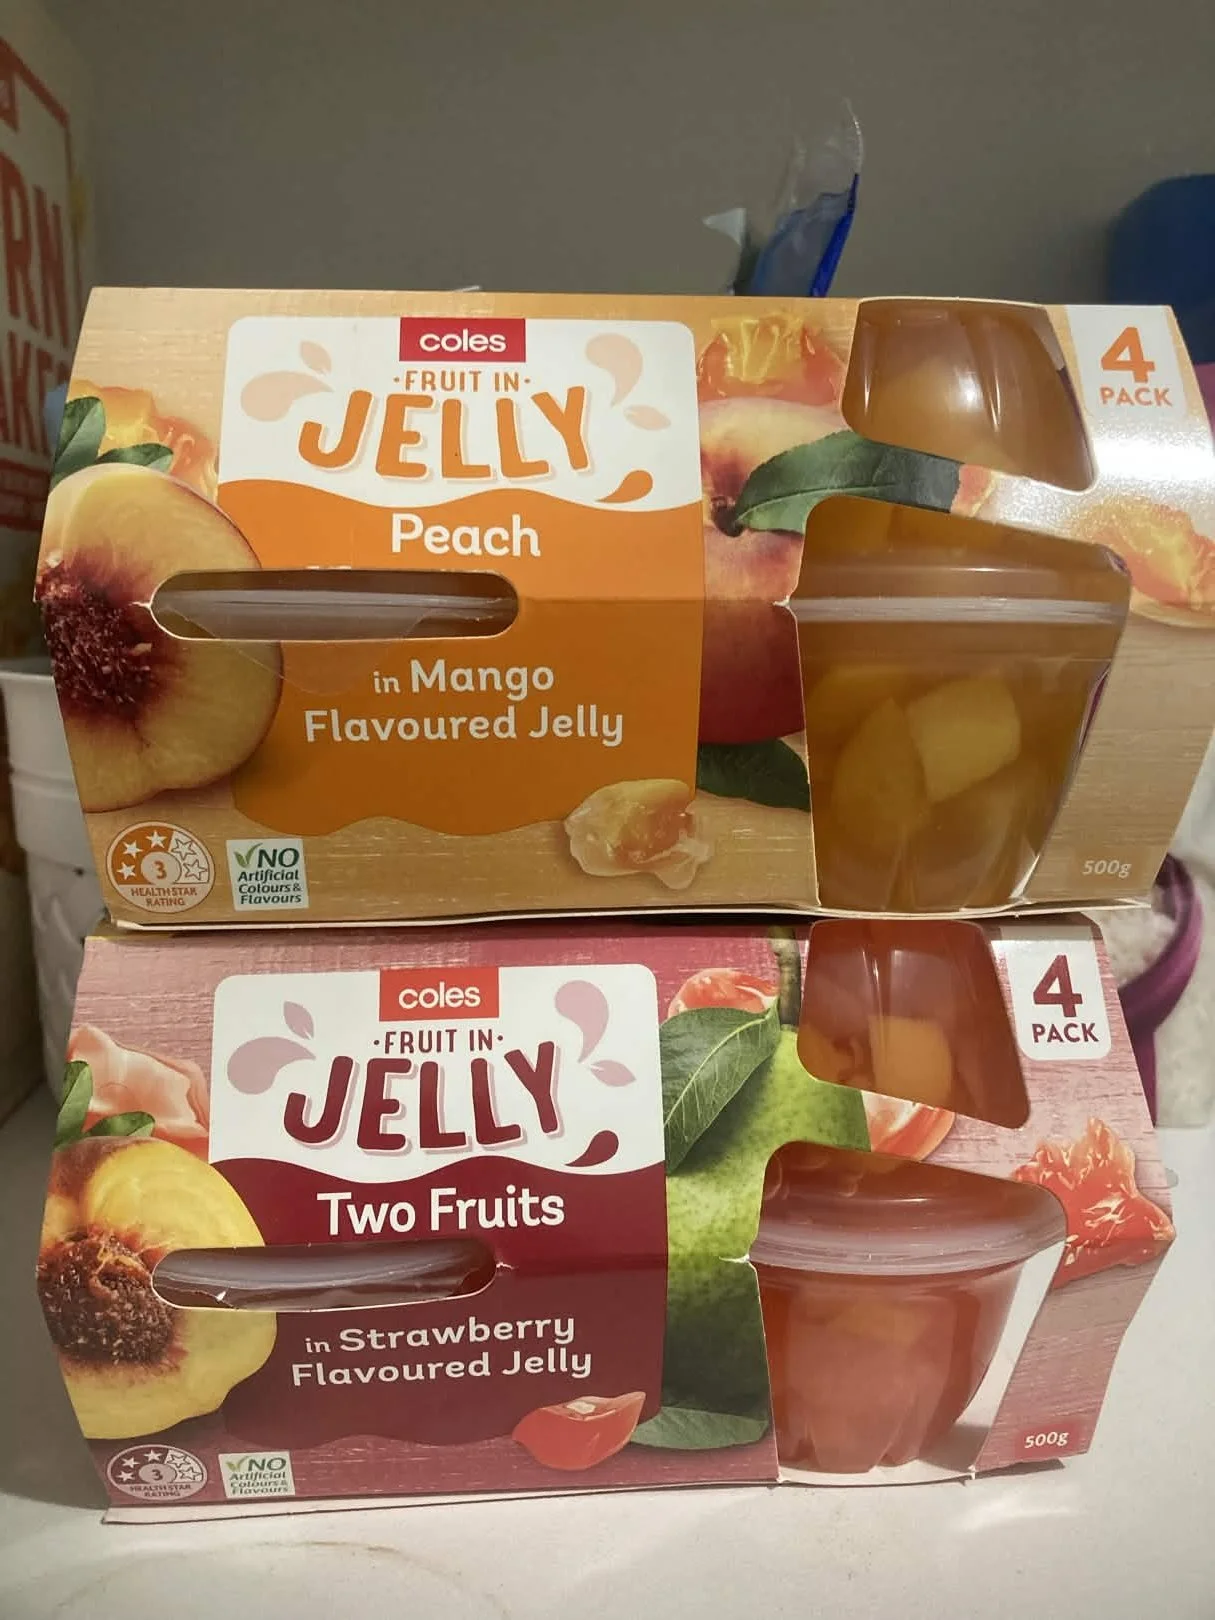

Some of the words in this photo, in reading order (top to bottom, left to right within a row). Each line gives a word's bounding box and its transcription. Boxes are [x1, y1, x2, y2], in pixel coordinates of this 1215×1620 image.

[419, 329, 506, 353] coles
[1101, 326, 1155, 383] 4
[405, 370, 482, 392] FRUIT
[494, 371, 520, 391] IN
[1100, 387, 1172, 407] PACK
[298, 385, 590, 480] JELLY
[391, 513, 541, 557] Peach
[373, 671, 401, 694] in
[410, 659, 555, 701] Mango
[304, 706, 517, 743] Flavoured
[528, 704, 624, 747] Jelly
[256, 848, 300, 868] NO
[152, 861, 167, 879] 3
[238, 869, 299, 883] Artificial
[1082, 860, 1132, 879] 500g
[131, 888, 171, 897] HEALTH
[172, 887, 198, 896] STAR
[238, 883, 291, 895] Colours
[292, 882, 301, 892] &
[146, 898, 186, 907] RATING
[240, 894, 302, 905] Flavours
[398, 982, 481, 1010] coles
[1033, 955, 1083, 1017] 4
[384, 1030, 458, 1053] FRUIT
[469, 1029, 494, 1051] IN
[1032, 1023, 1099, 1043] PACK
[284, 1041, 557, 1151] JELLY
[317, 1192, 416, 1236] Two
[430, 1184, 565, 1231] Fruits
[305, 1338, 331, 1353] in
[339, 1317, 575, 1351] Strawberry
[292, 1352, 491, 1386] Flavoured
[502, 1347, 592, 1379] Jelly
[1024, 1432, 1070, 1449] 500g
[248, 1457, 287, 1471] NO
[151, 1469, 163, 1481] 3
[230, 1471, 286, 1482] Artificial
[230, 1480, 280, 1489] Colours
[231, 1487, 289, 1495] Flavours
